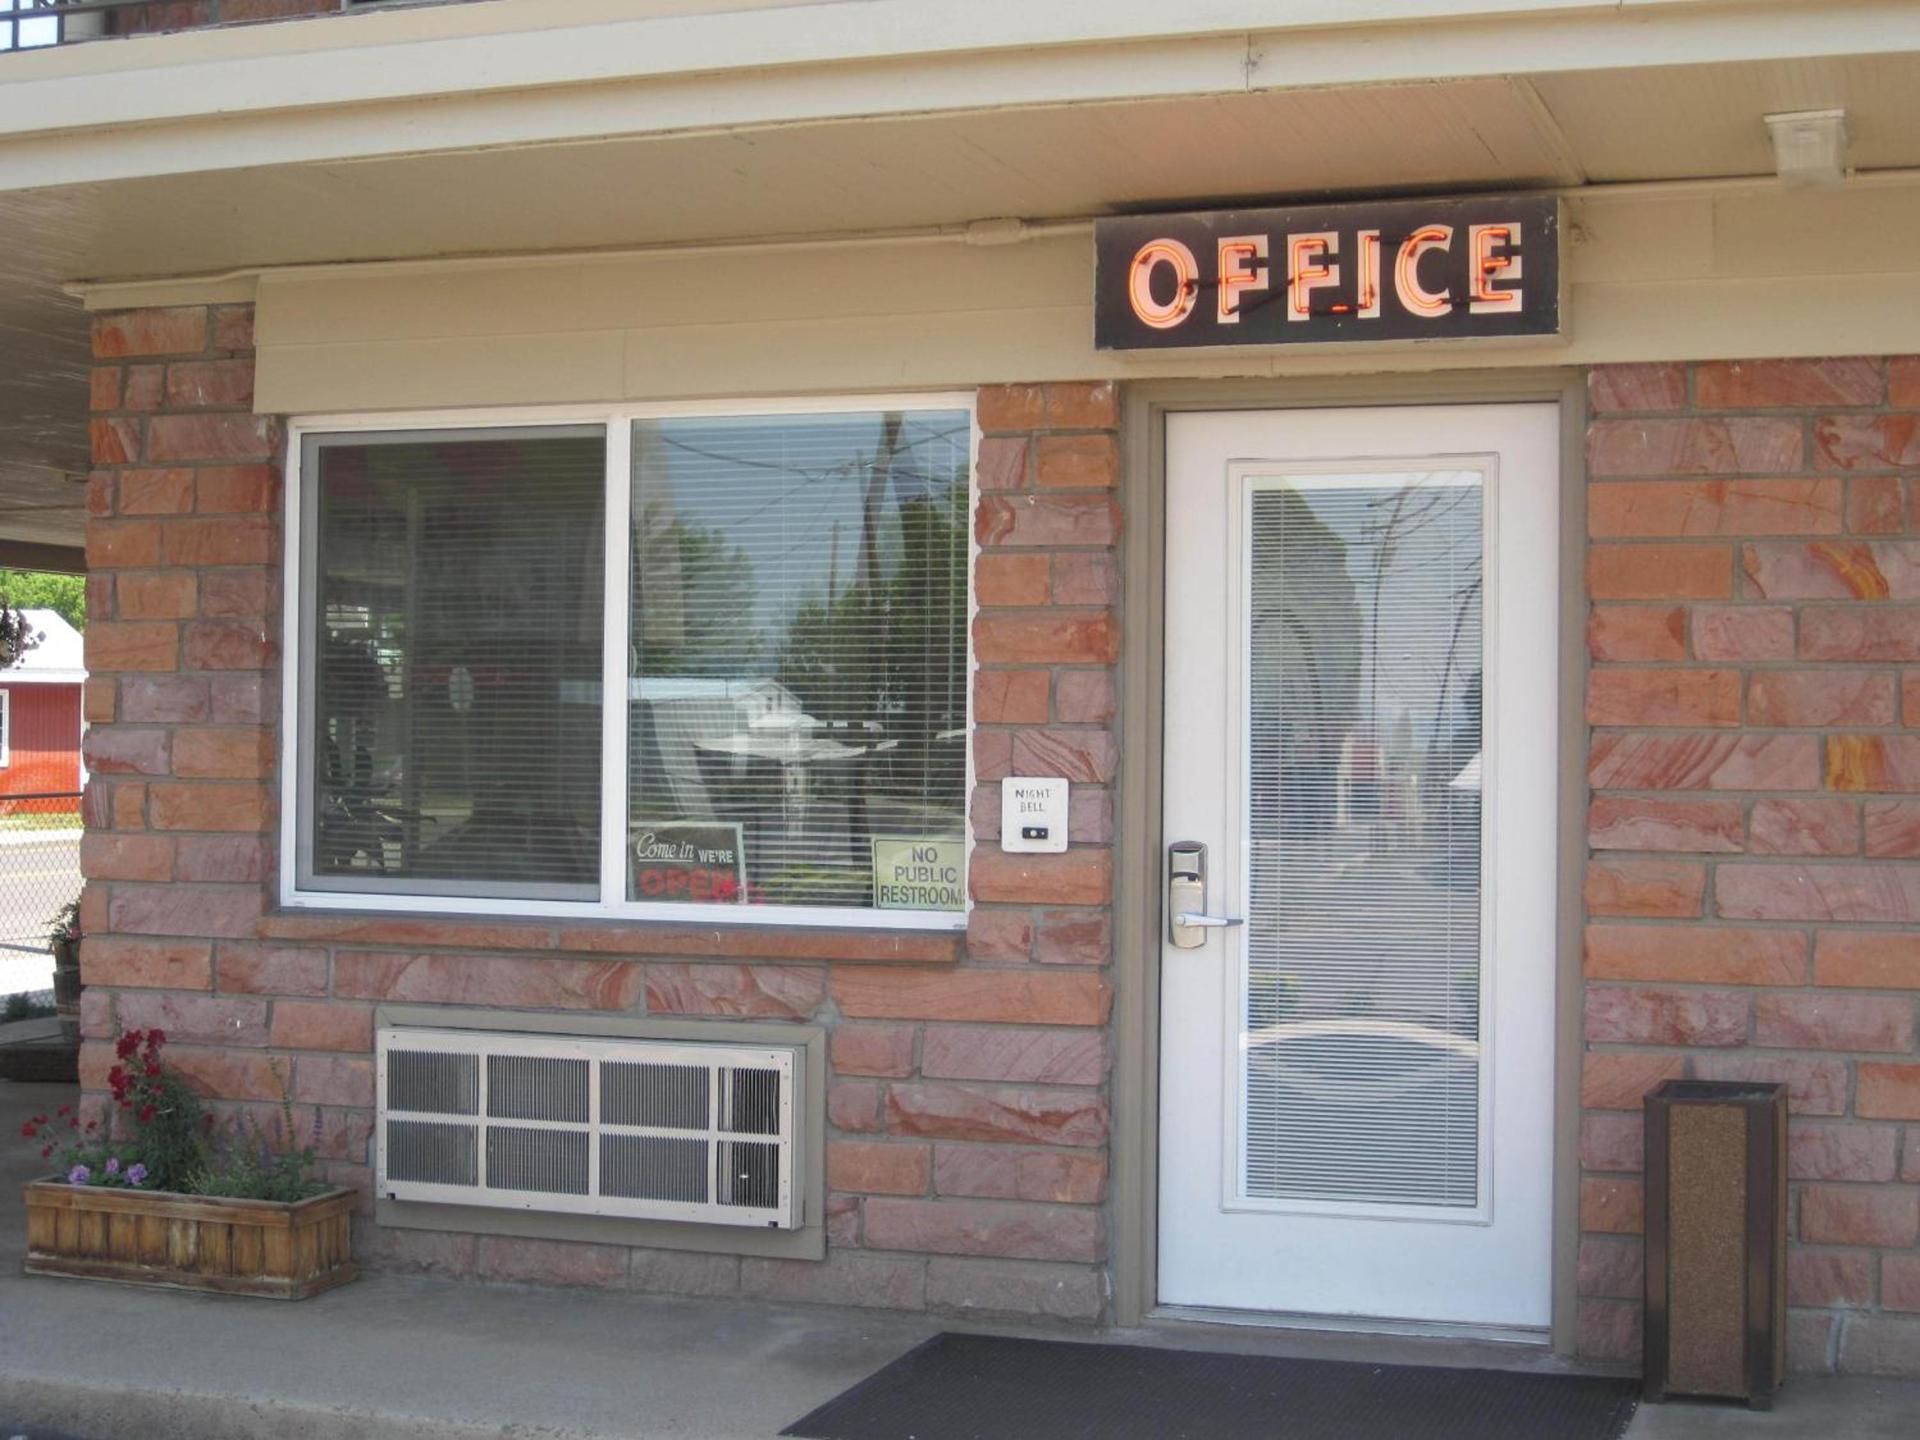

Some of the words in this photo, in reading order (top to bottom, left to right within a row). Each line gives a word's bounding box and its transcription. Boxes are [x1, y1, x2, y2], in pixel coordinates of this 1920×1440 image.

[1128, 221, 1523, 330] OFFICE
[1015, 788, 1050, 799] NIGHT
[1020, 802, 1045, 813] BELL
[636, 832, 677, 859] Come
[679, 841, 694, 859] in
[698, 849, 734, 863] WE'RE
[911, 847, 938, 863] NO
[894, 866, 957, 883] PUBLIC
[640, 867, 738, 902] OPEN
